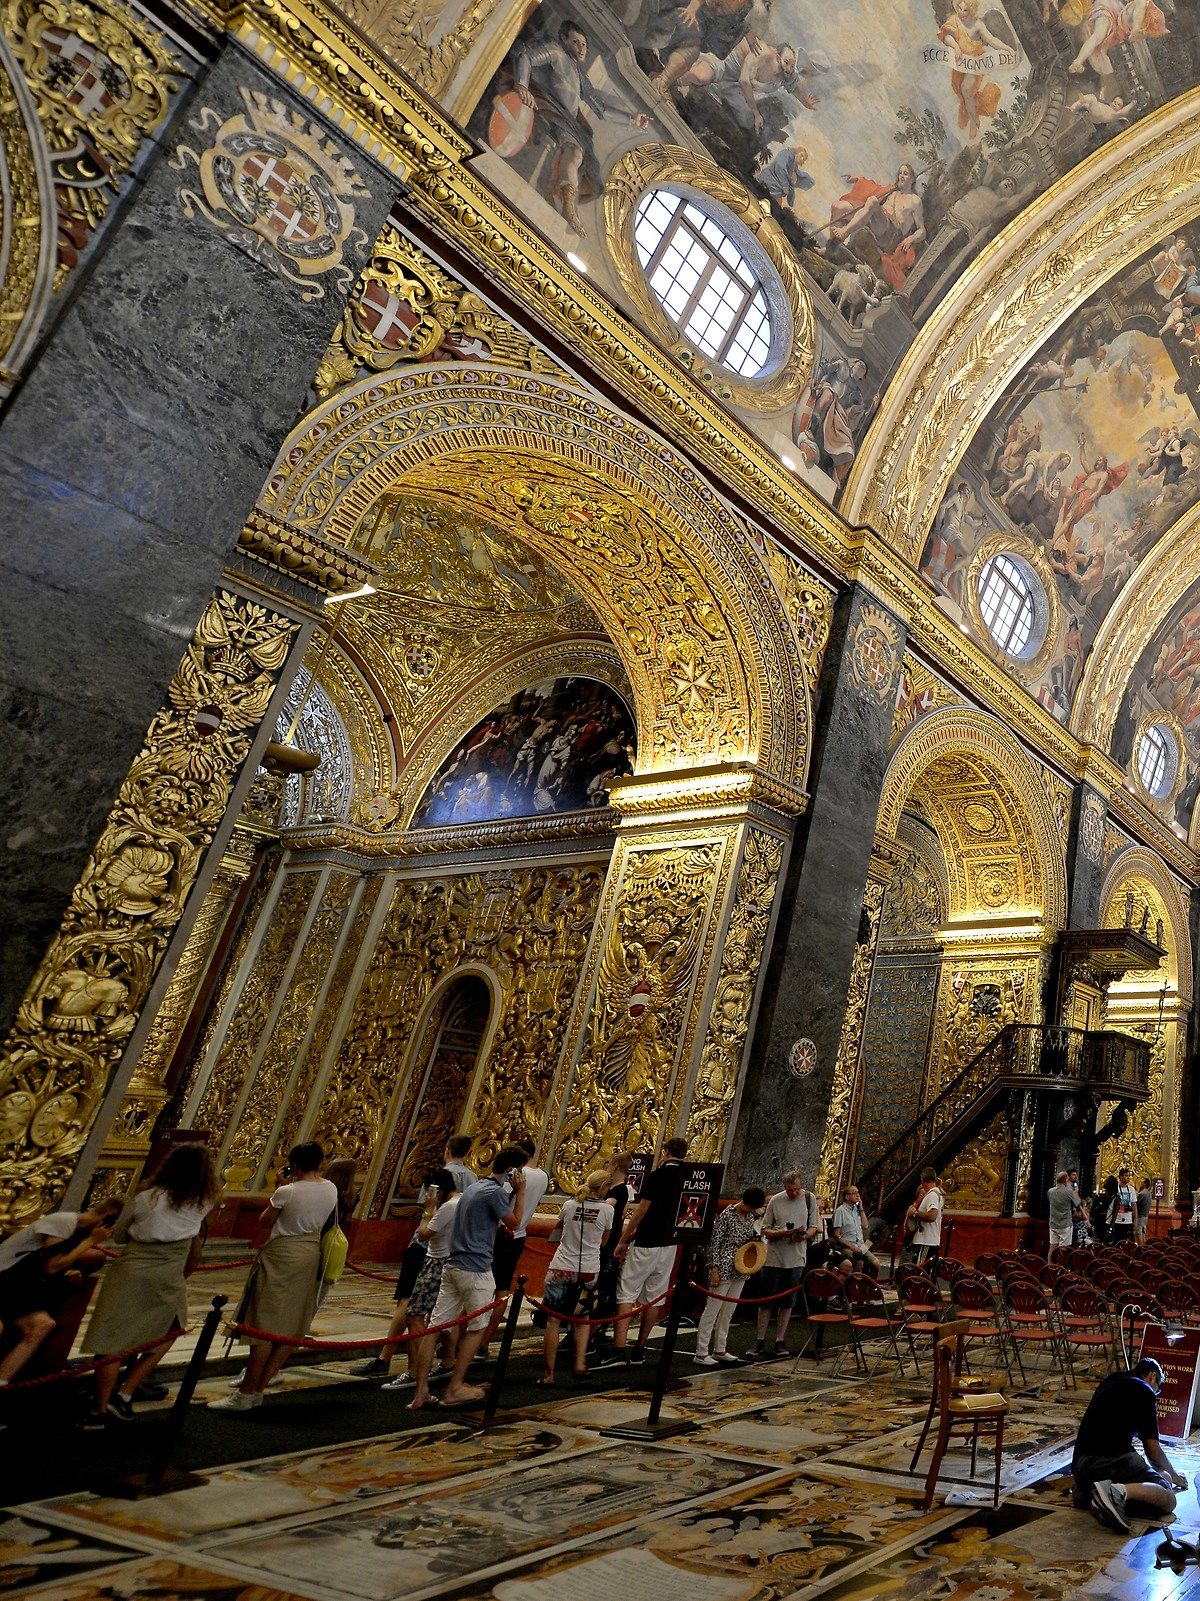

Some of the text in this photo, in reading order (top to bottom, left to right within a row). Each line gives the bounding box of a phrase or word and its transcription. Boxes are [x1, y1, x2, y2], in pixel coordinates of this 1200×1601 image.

[922, 48, 950, 63] ECCE
[958, 55, 994, 70] AGNVS
[692, 1170, 706, 1180] NO
[683, 1180, 711, 1191] FLASH
